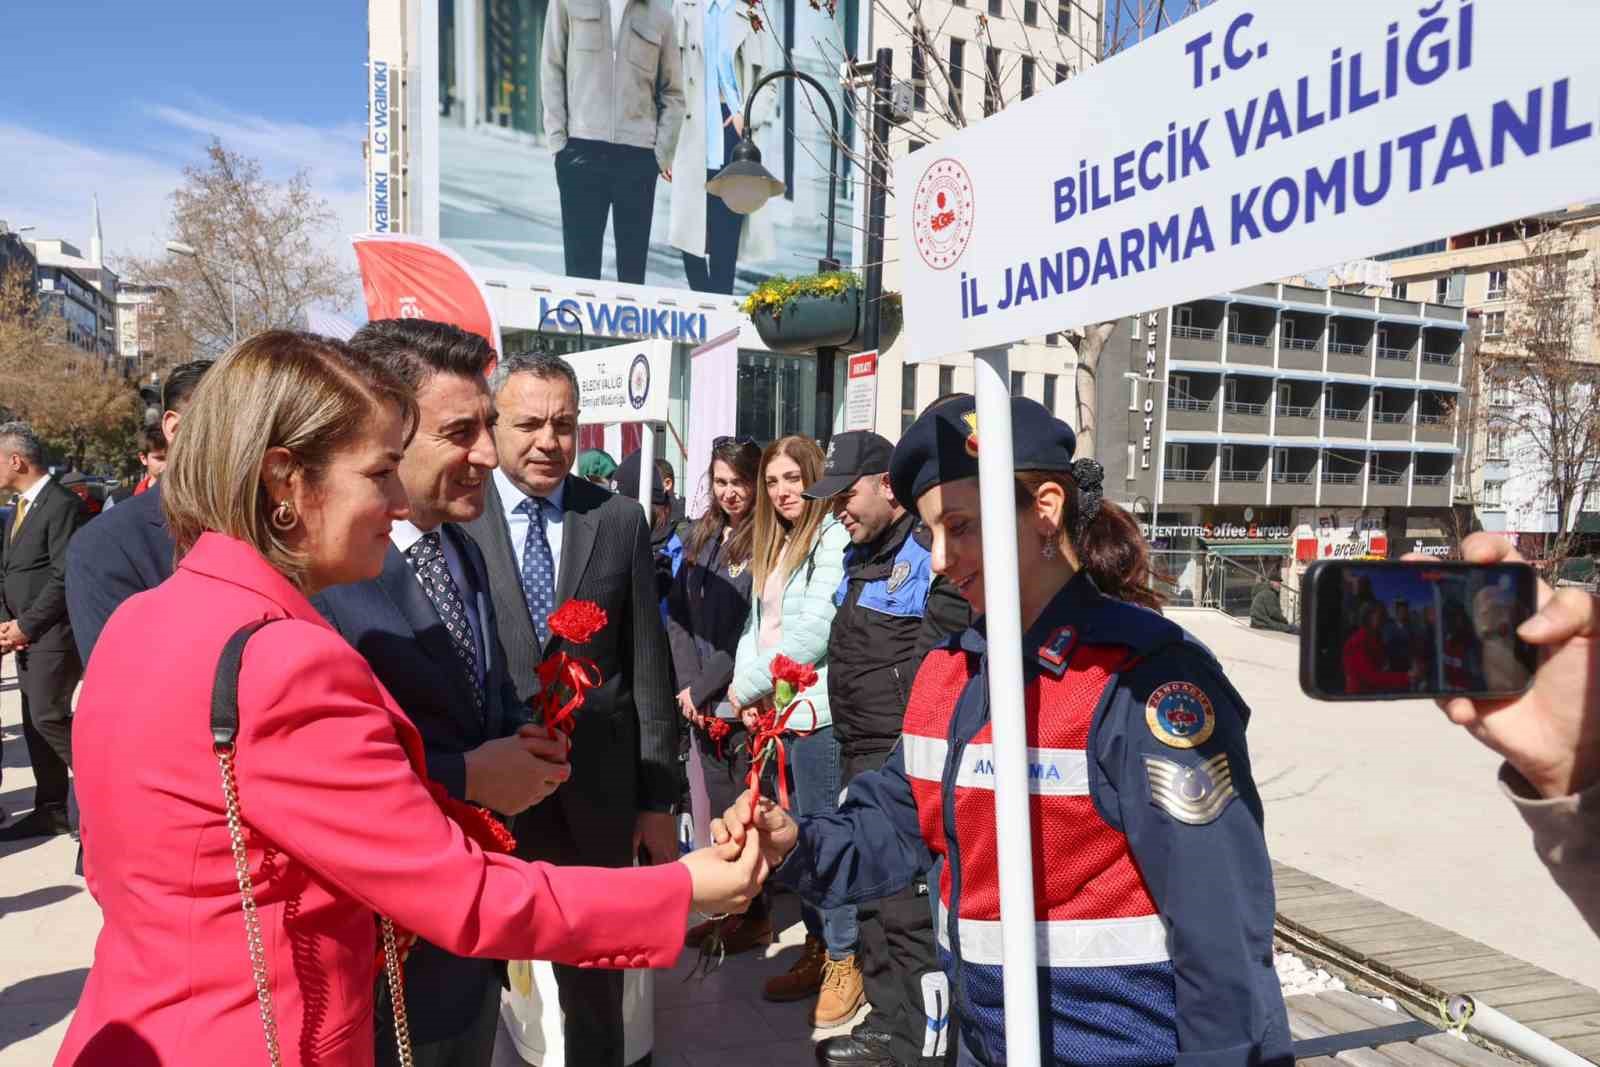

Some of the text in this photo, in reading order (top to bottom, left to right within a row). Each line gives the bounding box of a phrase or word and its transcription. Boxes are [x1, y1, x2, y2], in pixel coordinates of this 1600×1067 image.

[1186, 12, 1268, 89] T.C.
[960, 270, 988, 319] İL
[996, 207, 1215, 310] JANDARMA
[1230, 79, 1600, 247] KOMUTANL
[1055, 119, 1210, 224] BİLECİK
[539, 297, 581, 327] LC
[1141, 399, 1153, 469] OTEL
